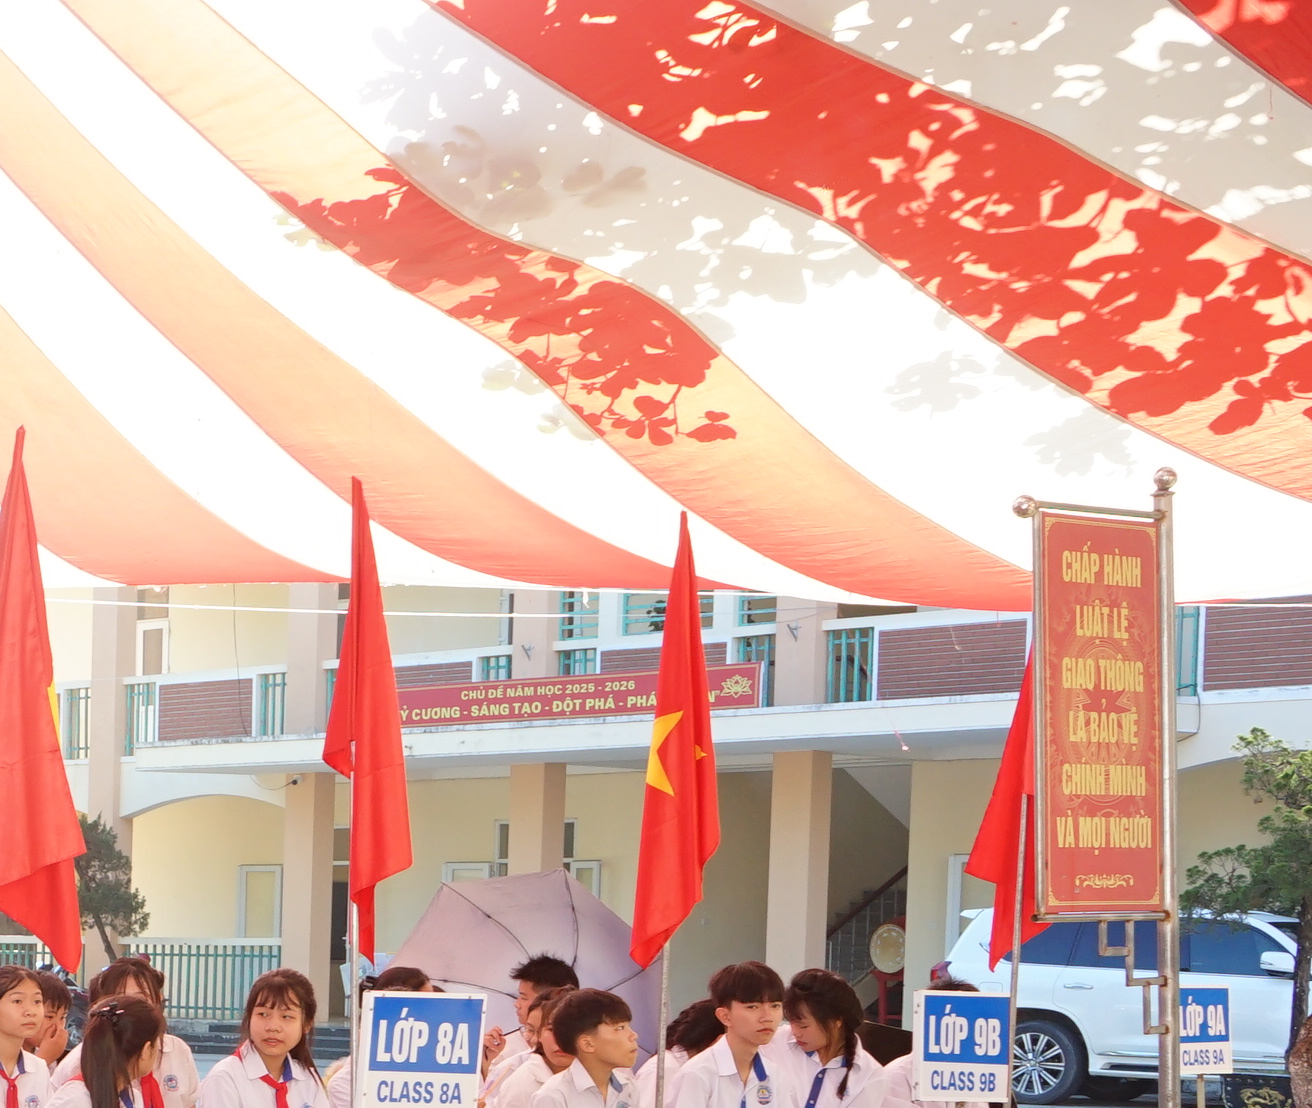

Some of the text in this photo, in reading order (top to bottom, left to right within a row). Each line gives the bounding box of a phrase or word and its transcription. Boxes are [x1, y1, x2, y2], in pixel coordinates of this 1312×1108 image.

[1062, 541, 1141, 588] CHẤP HÀNH
[1076, 600, 1129, 646] LUẬT LỆ
[461, 686, 485, 700] CHỦ
[488, 686, 504, 698] ĐỀ
[506, 685, 534, 698] NĂM
[537, 685, 563, 698] HỌC
[565, 683, 595, 694] 2025
[605, 681, 635, 692] 2026
[1062, 653, 1144, 692] GIAO THÔNG
[412, 706, 460, 720] CƯƠNG
[471, 702, 509, 717] SÁNG
[513, 702, 541, 717] TẠO
[552, 697, 582, 715] ĐỘT
[585, 693, 615, 710] PHÁ
[627, 690, 656, 708] PHÁ
[1090, 698, 1118, 743] BẢO
[1122, 706, 1138, 751] VỆ
[1062, 757, 1146, 796] CHÍNH MÌNH
[1056, 810, 1152, 856] VÀ MỌI NGƯỜI
[376, 1007, 470, 1065] LỚP 8A
[928, 1004, 1001, 1056] LỚP 9B
[1179, 995, 1226, 1037] LỚP 9A
[1182, 1049, 1225, 1066] CLASS 9A
[377, 1080, 462, 1104] CLASS 8A
[931, 1069, 996, 1092] CLASS 9B
